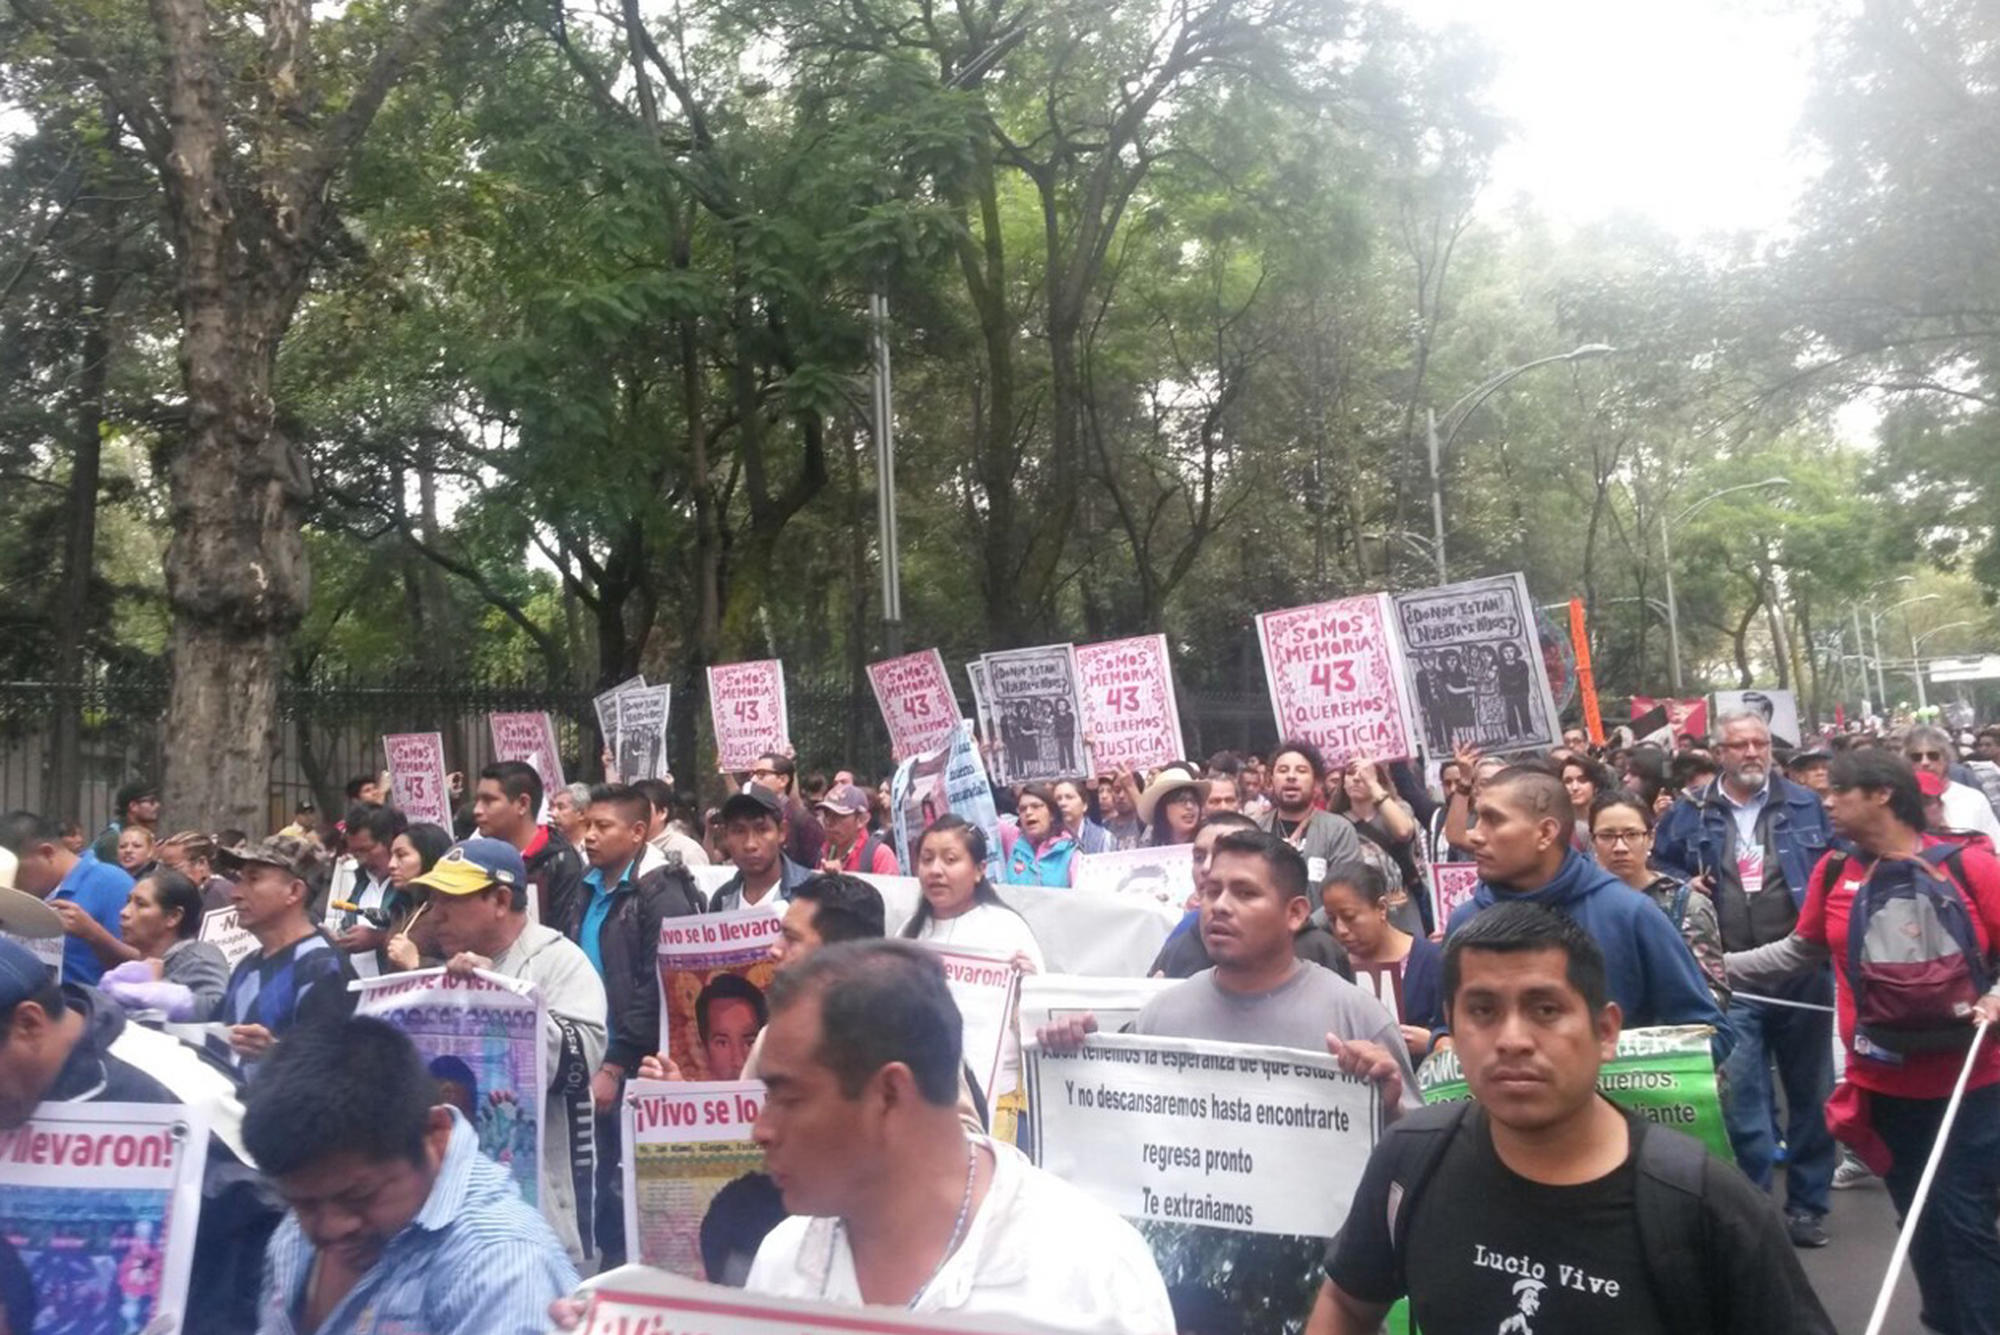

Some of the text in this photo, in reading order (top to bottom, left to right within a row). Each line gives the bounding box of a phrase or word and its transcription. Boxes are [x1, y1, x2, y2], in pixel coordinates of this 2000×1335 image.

[1293, 616, 1364, 644] SOMOS
[1095, 651, 1148, 673] SOMOS
[1285, 637, 1374, 664] MEMORIA
[726, 672, 767, 687] SOMOS
[888, 663, 930, 684] SOMOS
[1090, 667, 1155, 687] MEMORIA
[1310, 660, 1357, 697] 43
[721, 686, 772, 699] MEMORIA
[887, 678, 938, 698] MEMORIA
[1106, 686, 1140, 715] 43
[734, 700, 759, 723] 43
[903, 694, 931, 719] 43
[1296, 697, 1385, 723] QUEREMOS
[1095, 716, 1161, 734] QUEREMOS
[1302, 719, 1391, 748] JUSTICIA
[397, 746, 430, 759] SOMOS
[728, 741, 776, 757] JUSTICIA
[1098, 733, 1165, 758] JUSTICIA
[404, 776, 425, 800] 43
[685, 928, 700, 943] se
[702, 924, 716, 943] lo
[719, 918, 781, 941] llevaro
[944, 963, 1009, 989] evaron!
[637, 1094, 758, 1133] ¡Vivo se lo
[1065, 1080, 1349, 1131] Y no descansaremos hasta encontrarte
[1143, 1143, 1253, 1176] regresa pronto
[1142, 1187, 1253, 1225] Te extrañamos
[1473, 1244, 1620, 1298] Lucio Vive
